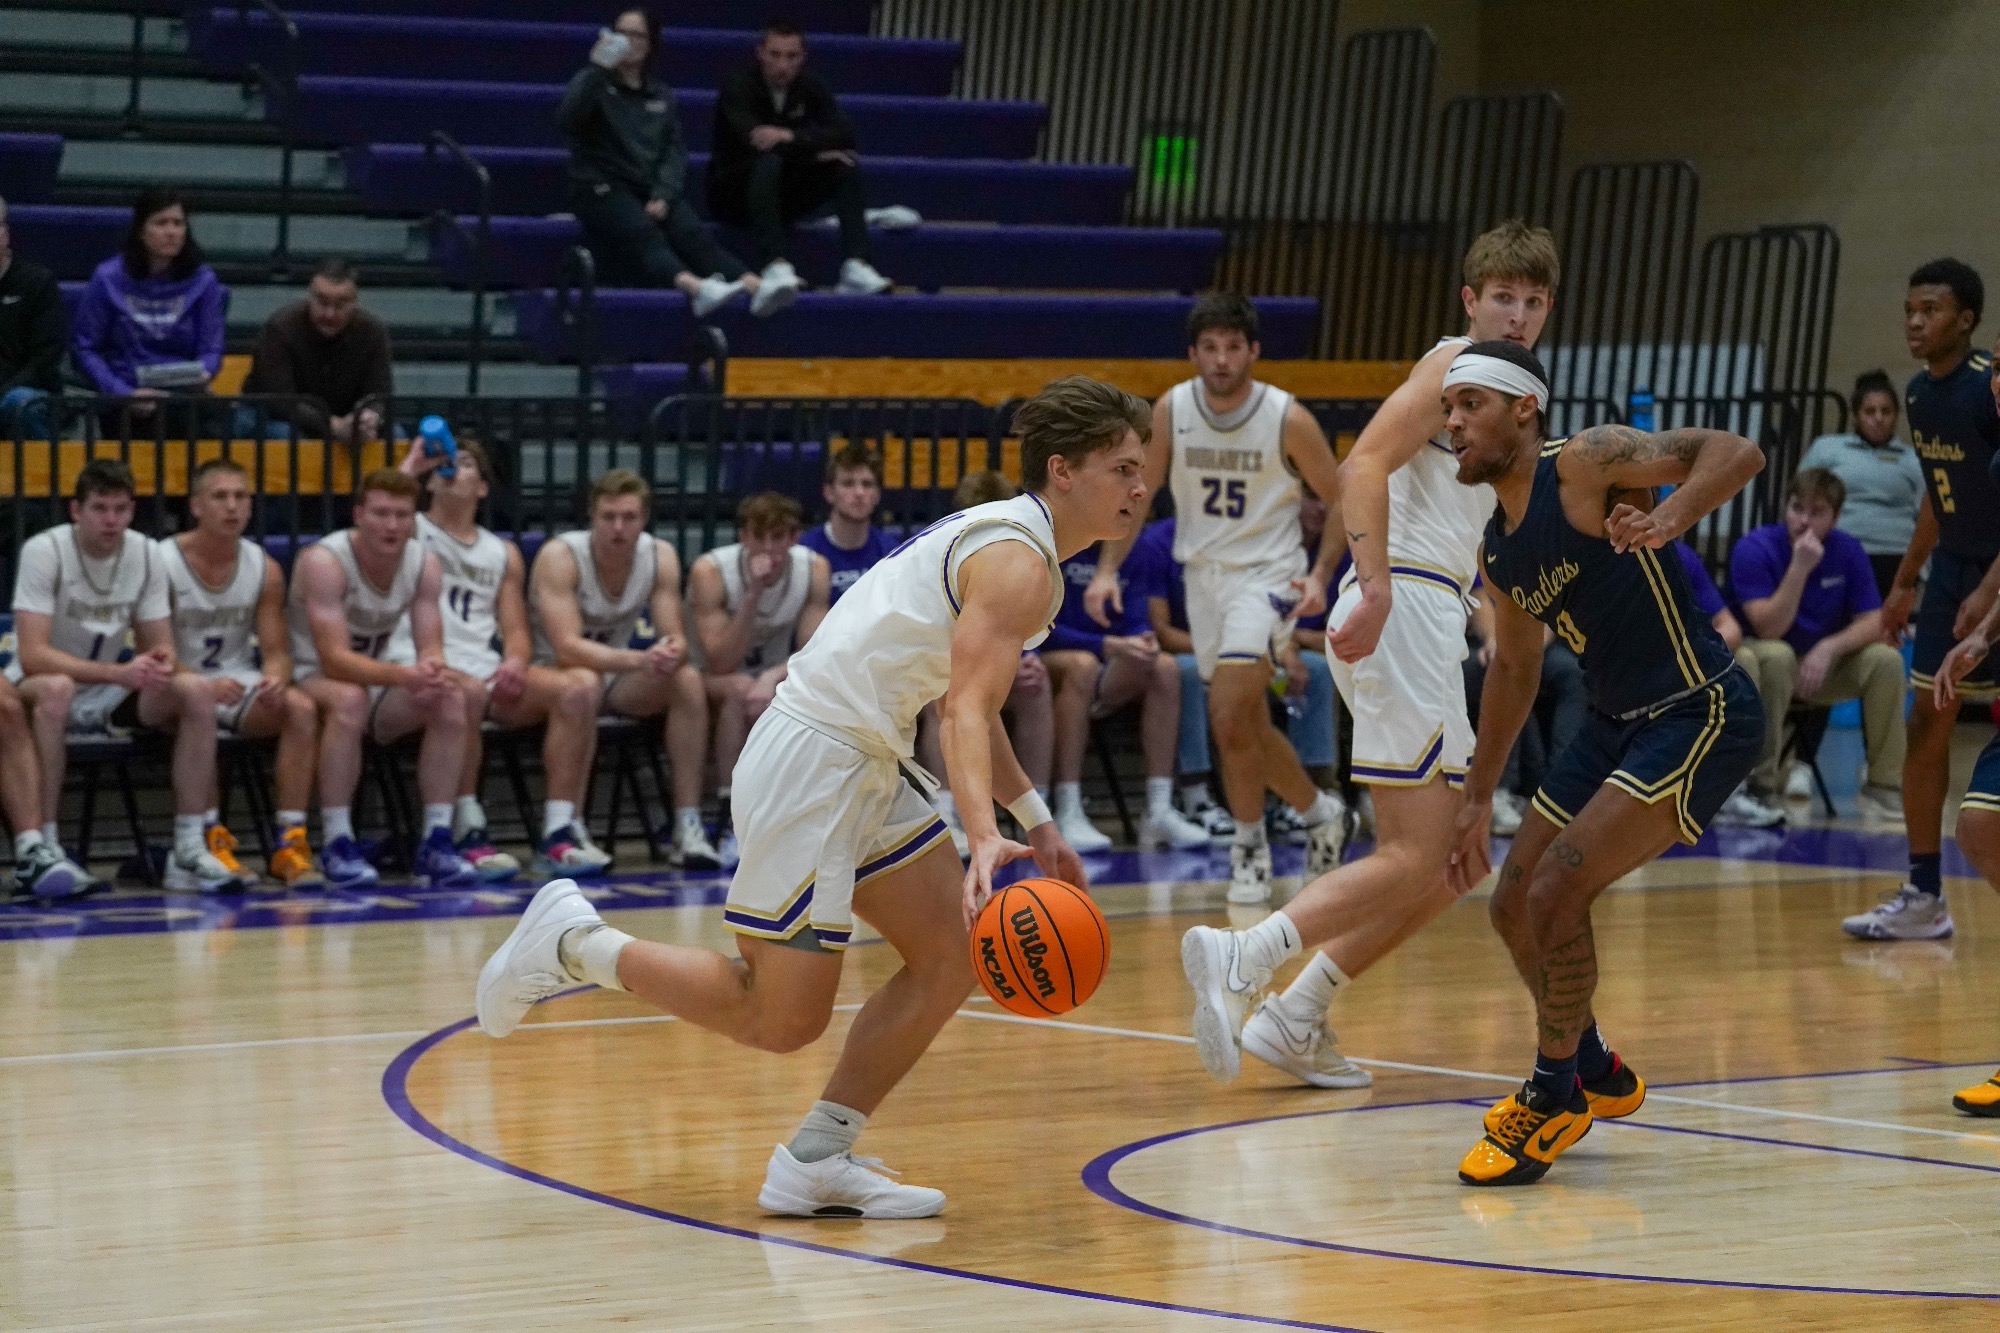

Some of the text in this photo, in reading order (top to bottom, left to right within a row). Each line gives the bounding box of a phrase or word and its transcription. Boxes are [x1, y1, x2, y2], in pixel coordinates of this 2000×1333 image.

[1201, 477, 1246, 518] 25
[1933, 470, 1955, 513] 2
[202, 636, 224, 670] 2
[1556, 609, 1587, 655] 0
[980, 936, 1017, 1000] NCAA
[1011, 905, 1056, 999] Wilson
